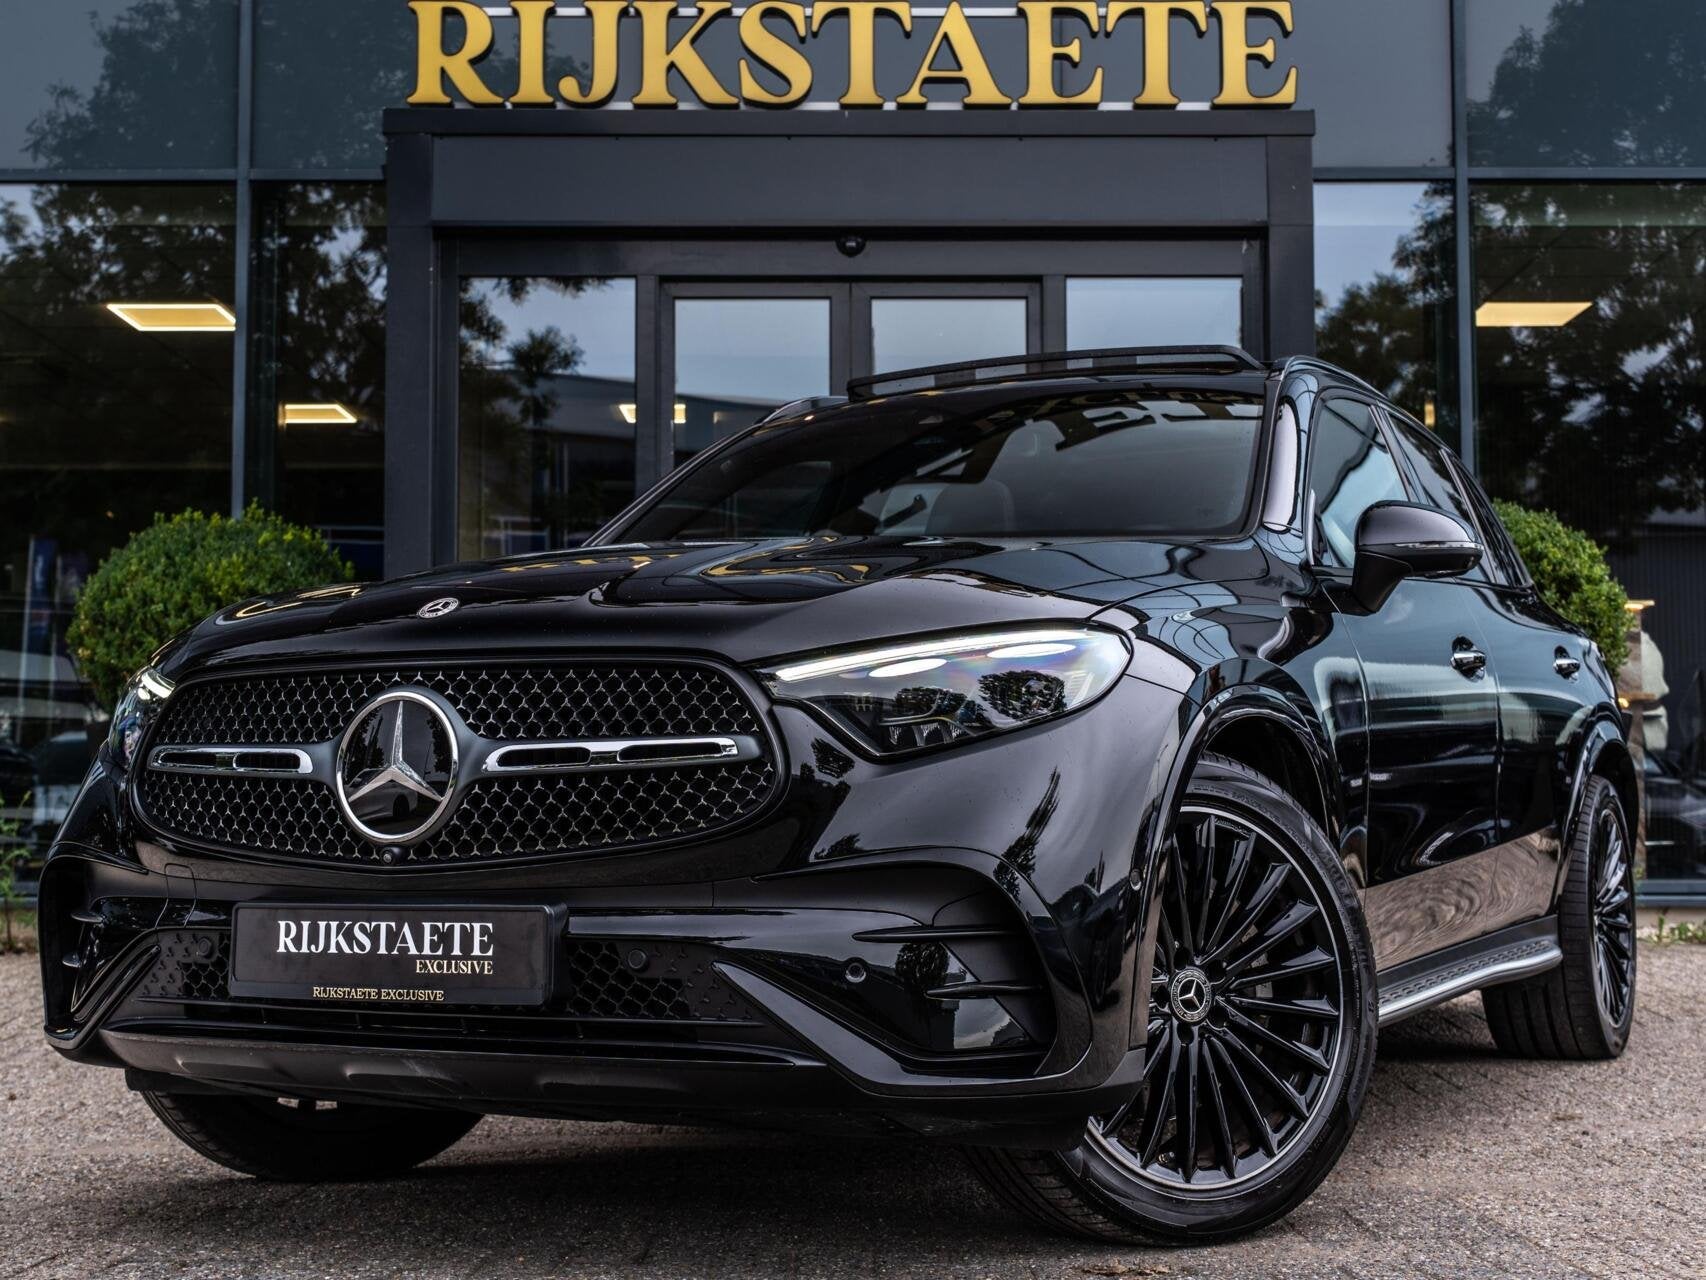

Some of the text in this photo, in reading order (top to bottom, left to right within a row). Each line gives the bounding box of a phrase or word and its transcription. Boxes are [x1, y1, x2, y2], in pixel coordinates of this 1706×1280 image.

[406, 0, 1298, 108] RIJKSTAETE
[276, 920, 493, 956] RIJKSTAETE
[415, 959, 493, 975] EXCLUSIVE
[312, 986, 445, 1001] RIJKSTAETE EXCLUSIVE
